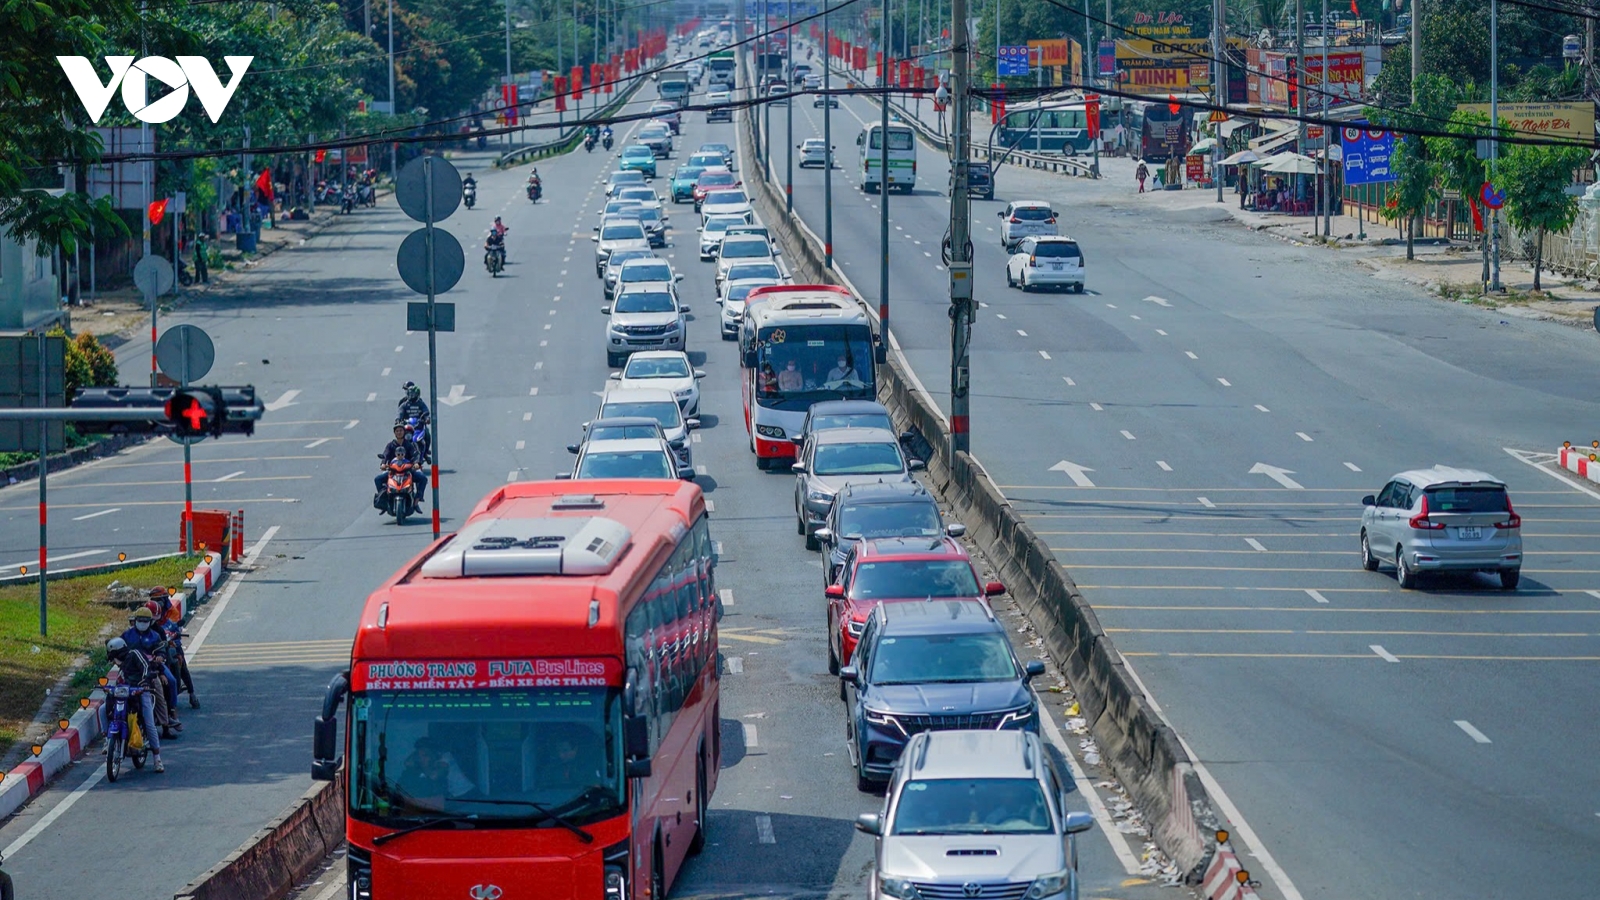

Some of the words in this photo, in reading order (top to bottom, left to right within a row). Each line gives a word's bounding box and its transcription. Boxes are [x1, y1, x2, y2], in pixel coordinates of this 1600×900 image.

[1134, 69, 1177, 85] MINH
[1343, 68, 1362, 82] LAN
[1348, 129, 1357, 138] 60
[368, 661, 425, 678] PHƯƠNG
[428, 662, 476, 678] TRANG
[488, 660, 535, 676] FUTA
[536, 659, 564, 676] Bus
[565, 659, 605, 676] Lines
[366, 678, 391, 690] BẾN
[393, 681, 411, 689] XE
[448, 679, 477, 689] TÂY
[489, 676, 515, 688] BẾN
[517, 679, 534, 687] XE
